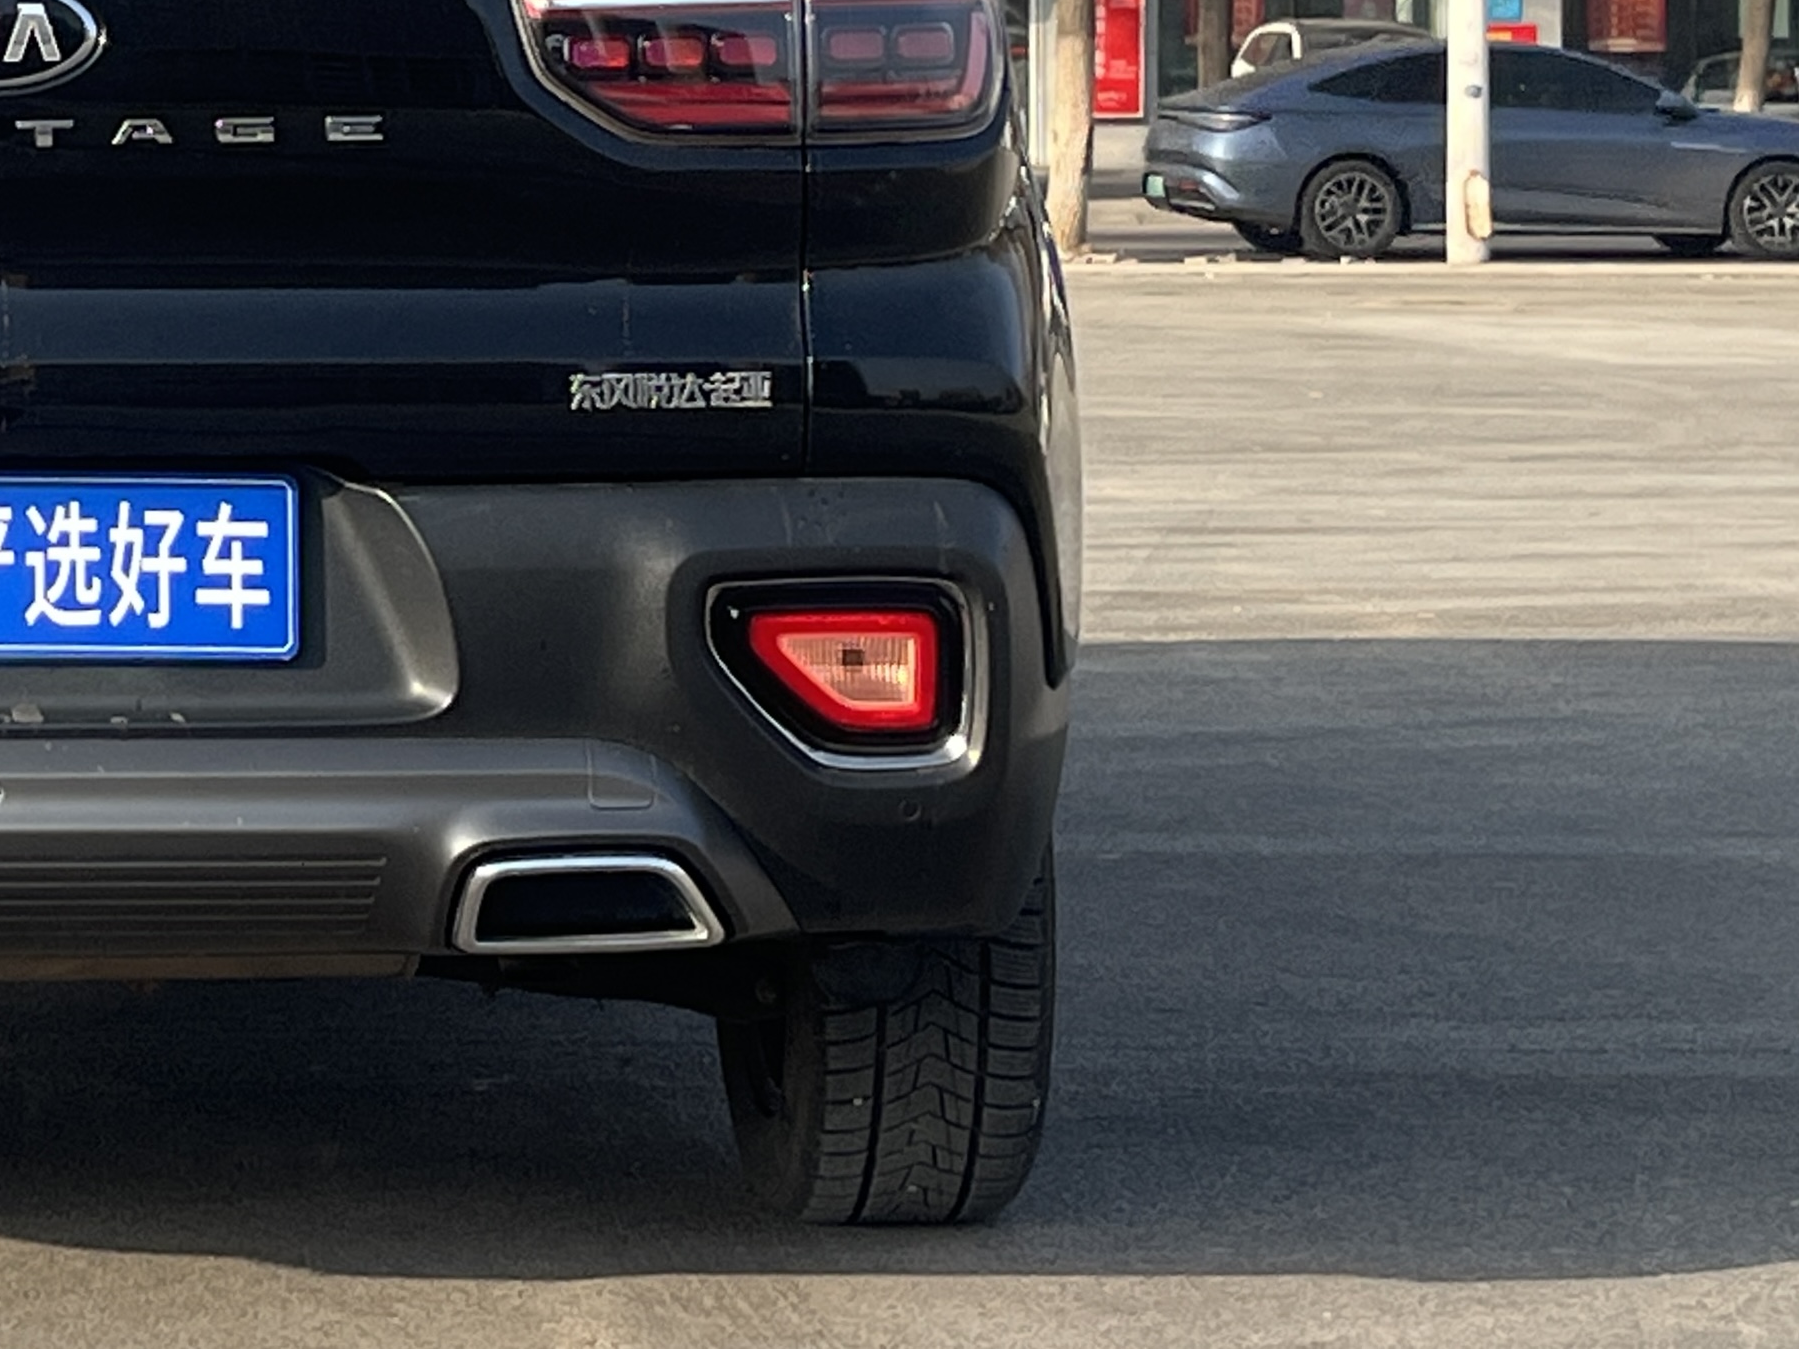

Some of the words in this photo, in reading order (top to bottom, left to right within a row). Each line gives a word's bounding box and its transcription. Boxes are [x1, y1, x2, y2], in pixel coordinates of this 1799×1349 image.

[568, 371, 774, 411] 东风悦达起亚
